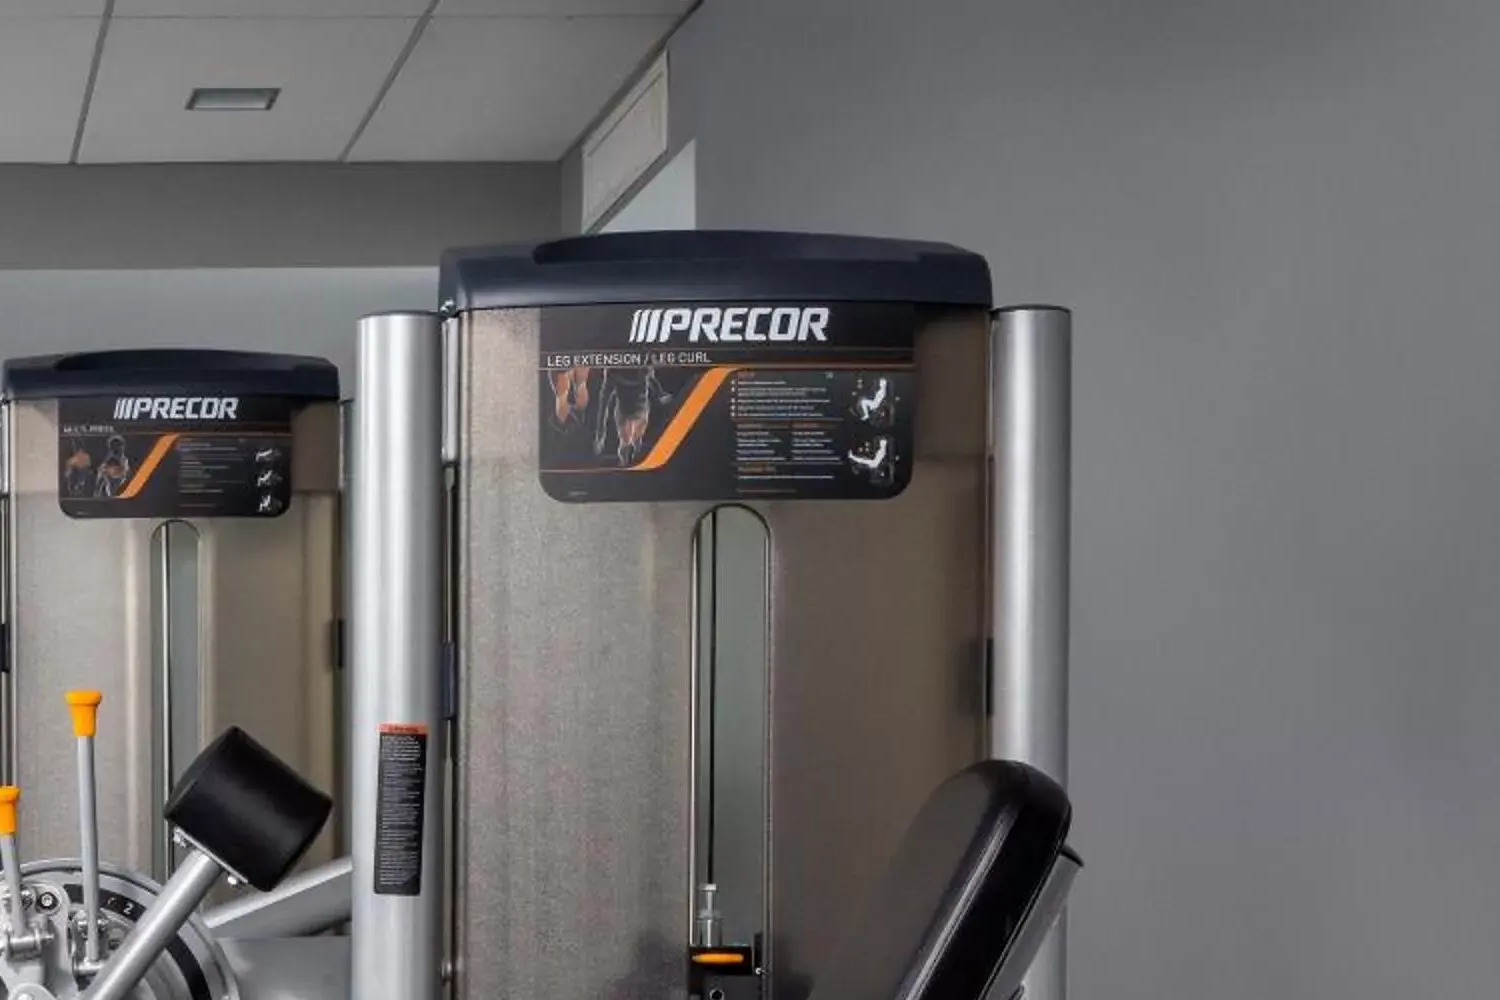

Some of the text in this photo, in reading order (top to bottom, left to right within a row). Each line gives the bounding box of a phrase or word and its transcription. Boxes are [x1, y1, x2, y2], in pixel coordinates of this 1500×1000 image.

[658, 306, 830, 343] PRECOR
[546, 354, 571, 368] LEG
[573, 352, 642, 367] EXTENSION
[677, 351, 713, 364] CURL
[131, 397, 240, 420] PRECOR
